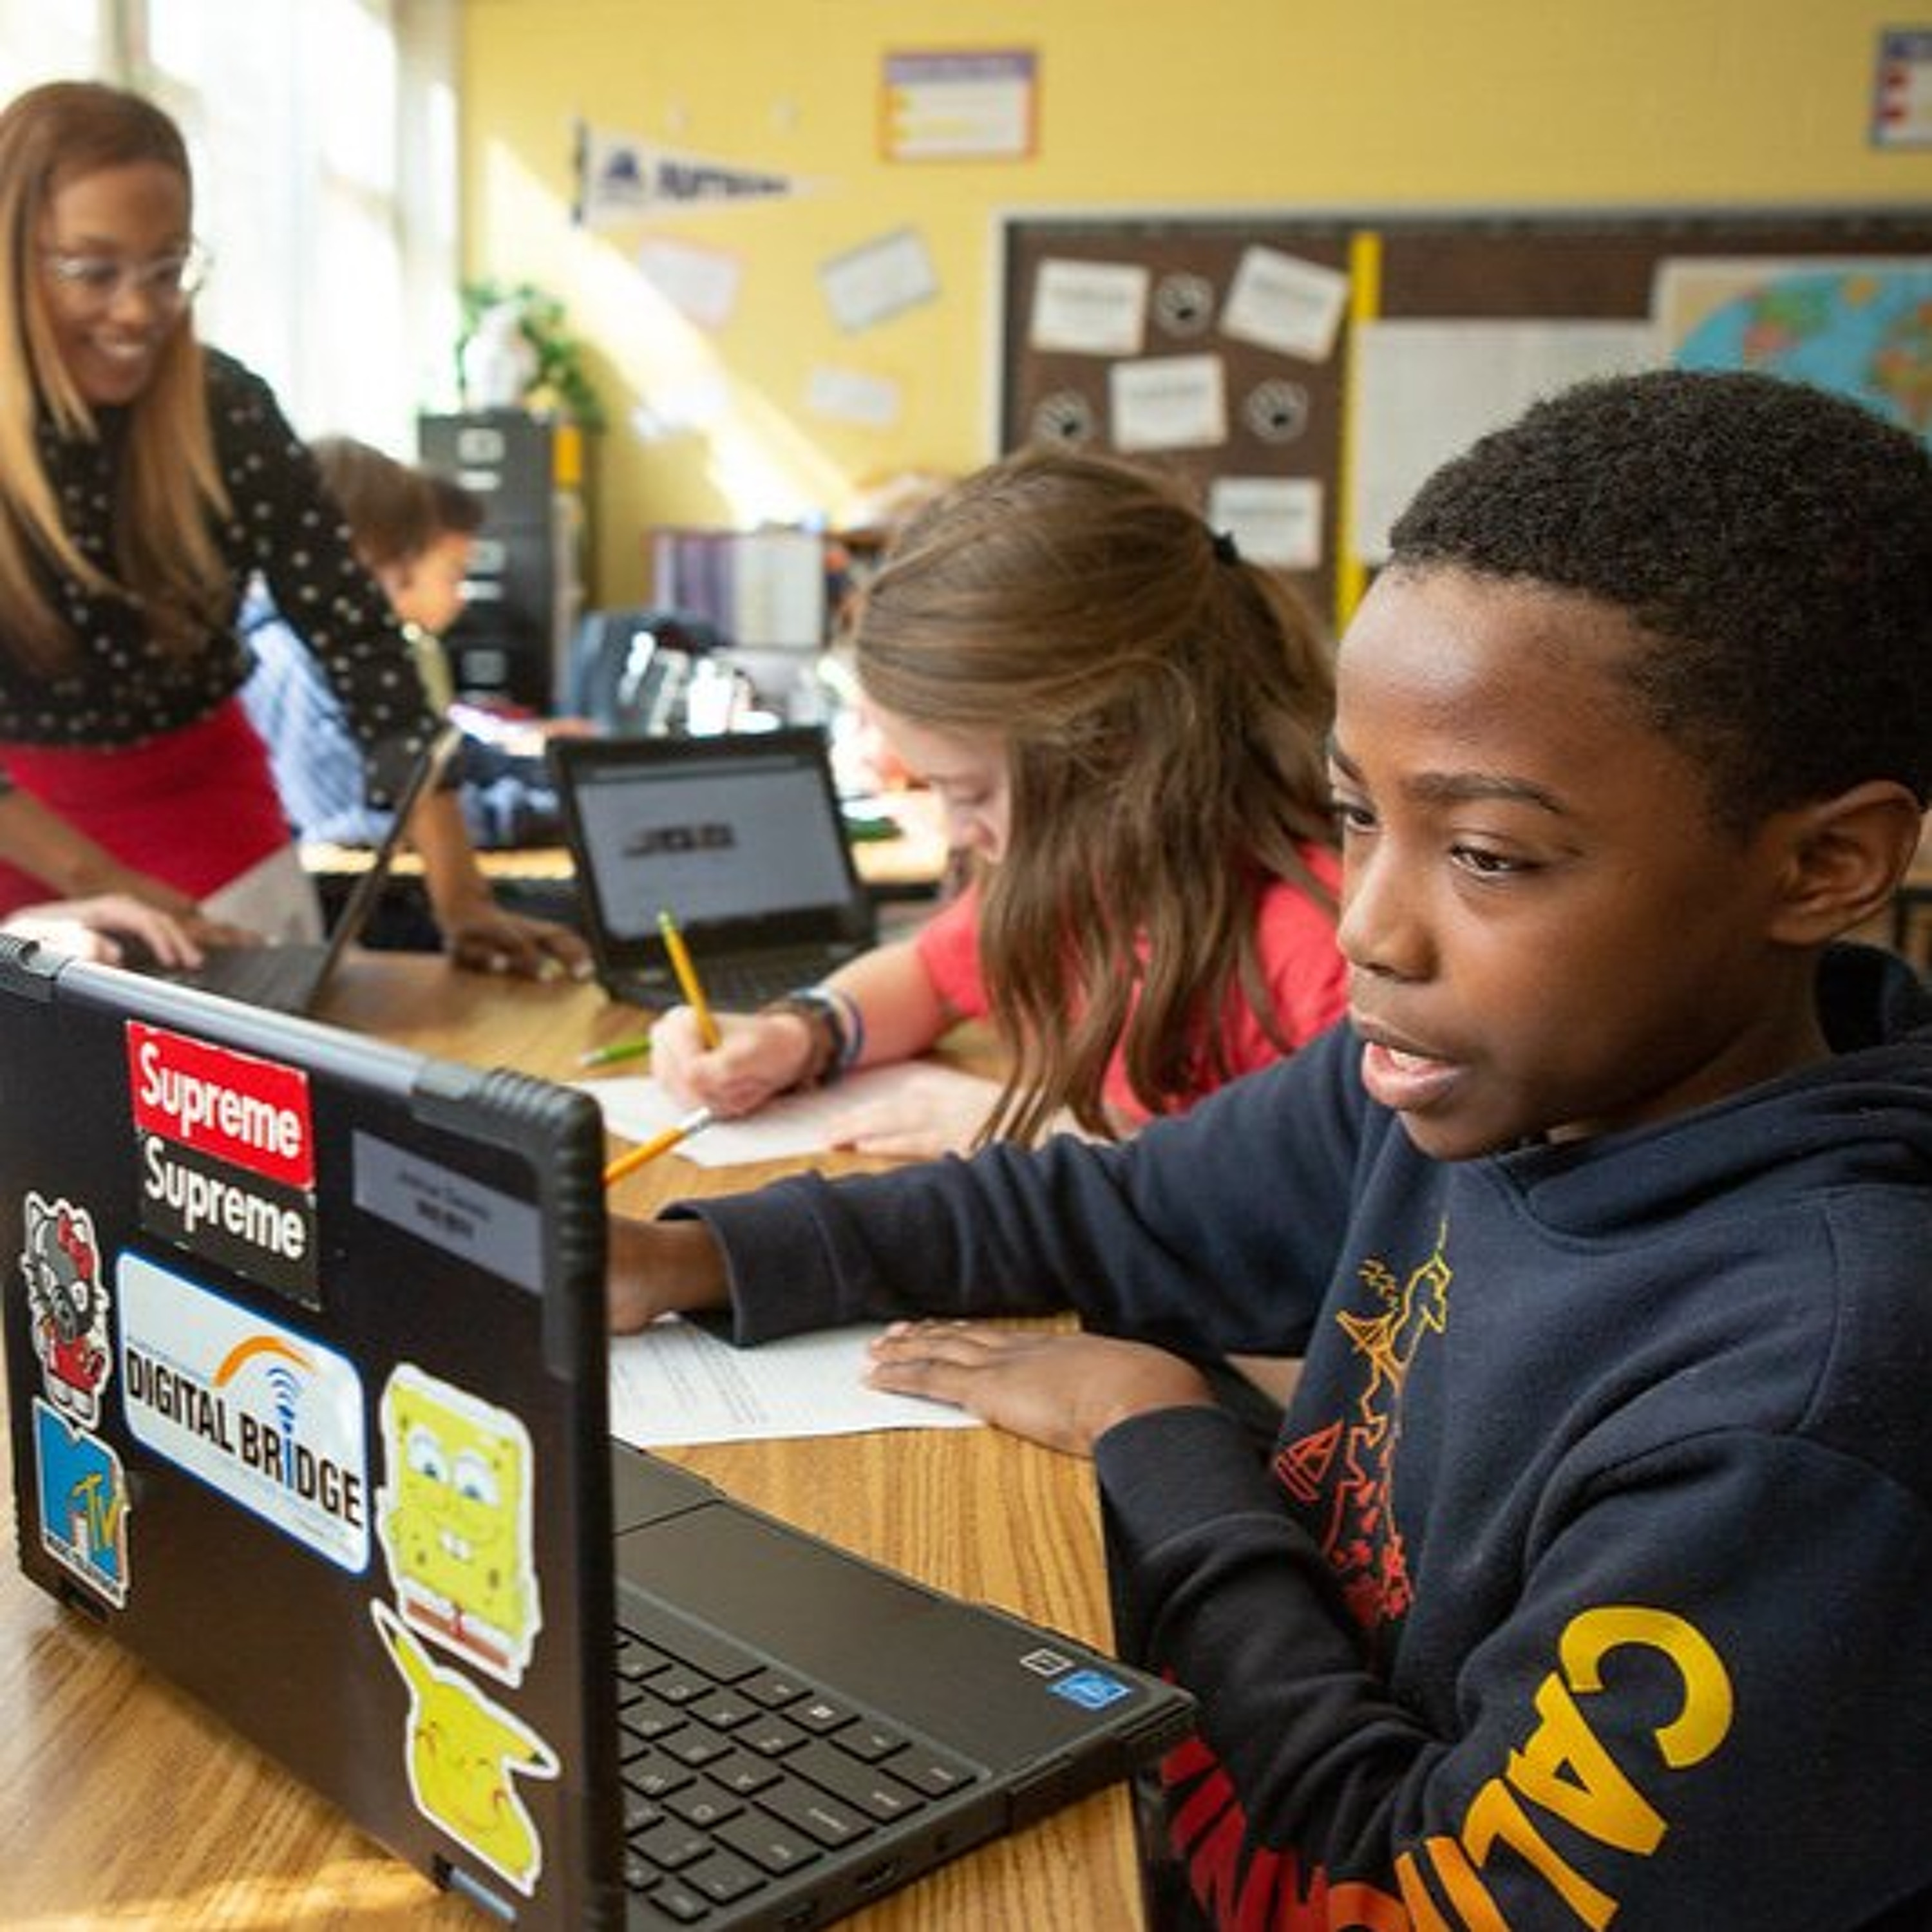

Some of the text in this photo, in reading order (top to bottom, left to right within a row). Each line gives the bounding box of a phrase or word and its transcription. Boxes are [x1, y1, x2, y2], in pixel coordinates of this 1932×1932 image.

[140, 1041, 301, 1159] Supreme
[144, 1135, 305, 1259] Supreme
[126, 1347, 234, 1454] DIGITAL
